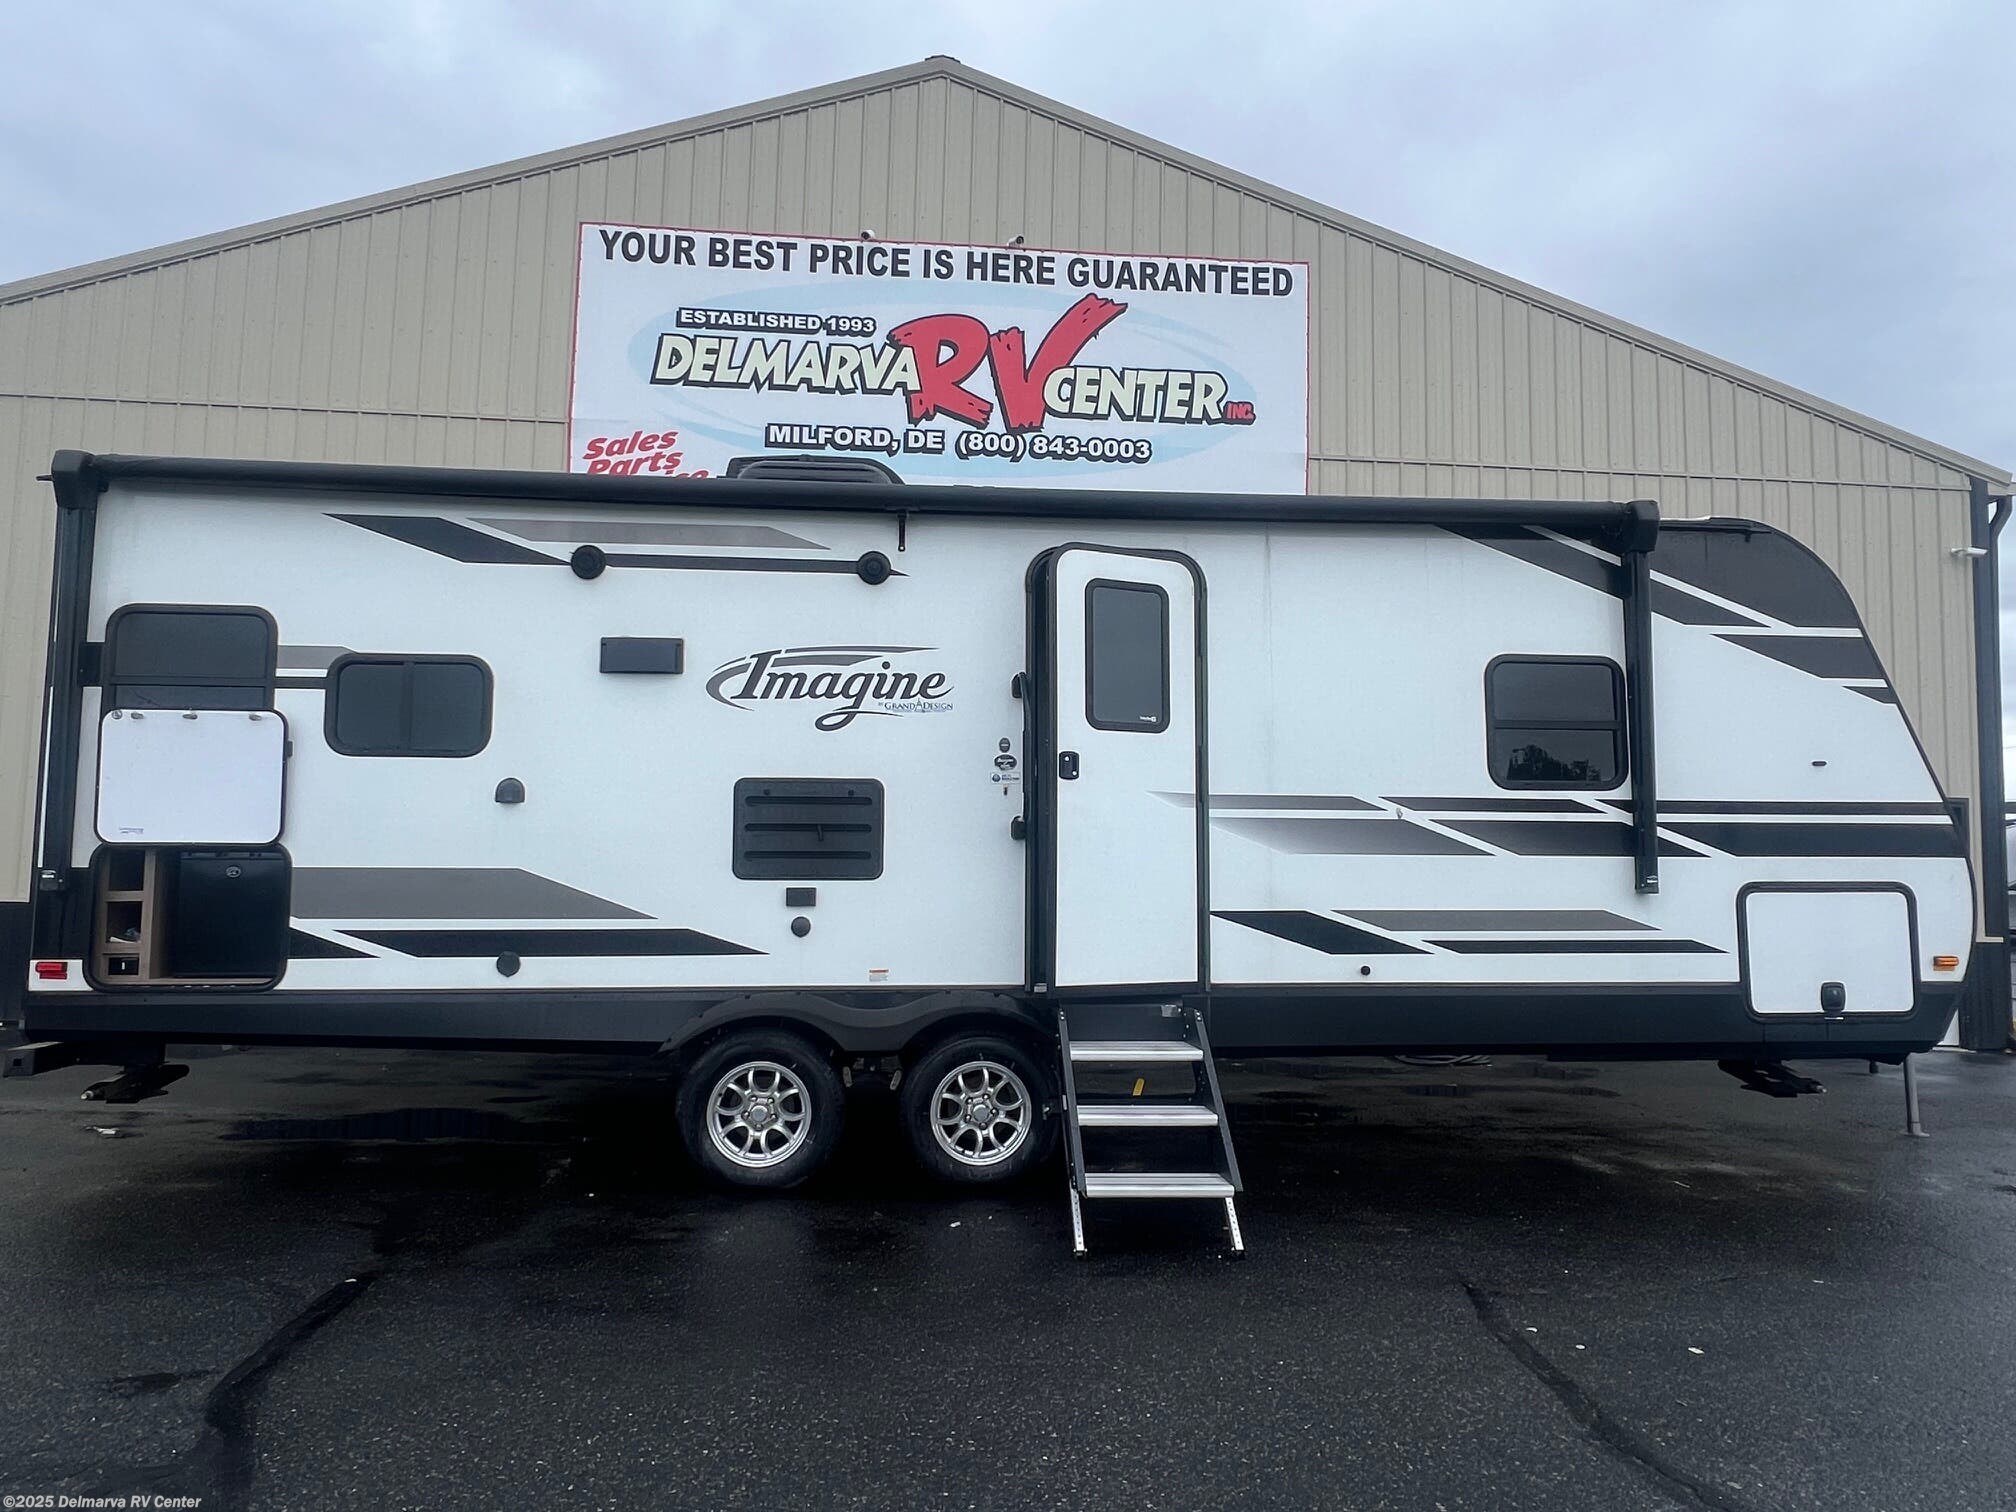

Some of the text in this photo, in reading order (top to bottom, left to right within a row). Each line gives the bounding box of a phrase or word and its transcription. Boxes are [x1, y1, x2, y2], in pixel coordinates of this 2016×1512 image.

[600, 229, 1293, 297] YOUR BEST PRICE IS HERE GUARANTEED
[679, 309, 875, 333] ESTABLISHED 1993
[650, 333, 923, 394] DELMARVA
[887, 293, 1128, 432] RV
[1044, 365, 1228, 424] CENTER
[582, 430, 679, 460] Sales
[767, 425, 1151, 460] MILFORD, DE (800) 843-0003
[586, 452, 684, 476] Parts
[730, 649, 955, 732] Imagine
[884, 701, 916, 711] GRAND
[922, 701, 954, 711] DESIGN
